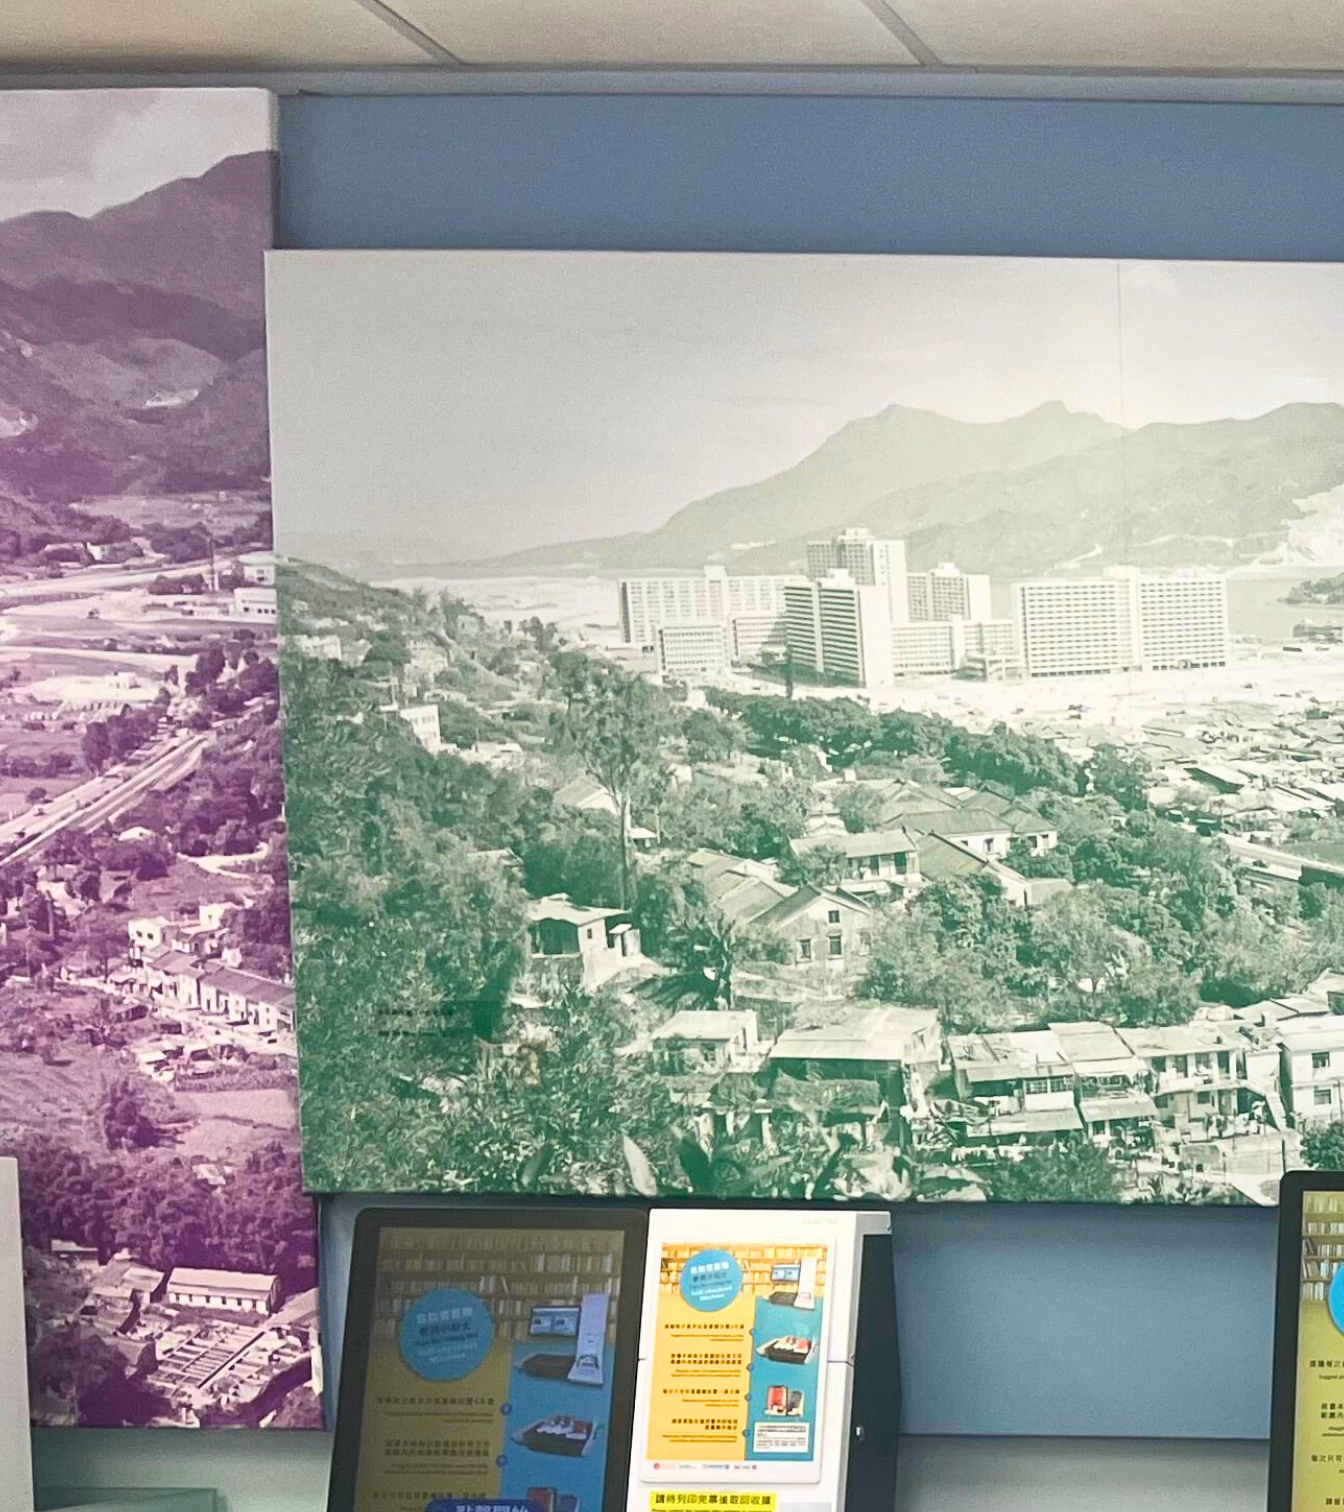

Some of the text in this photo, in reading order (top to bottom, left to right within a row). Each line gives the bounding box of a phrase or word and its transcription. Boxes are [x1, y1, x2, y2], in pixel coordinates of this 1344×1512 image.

[655, 1494, 771, 1506] 請待列印完畢後取回收據
